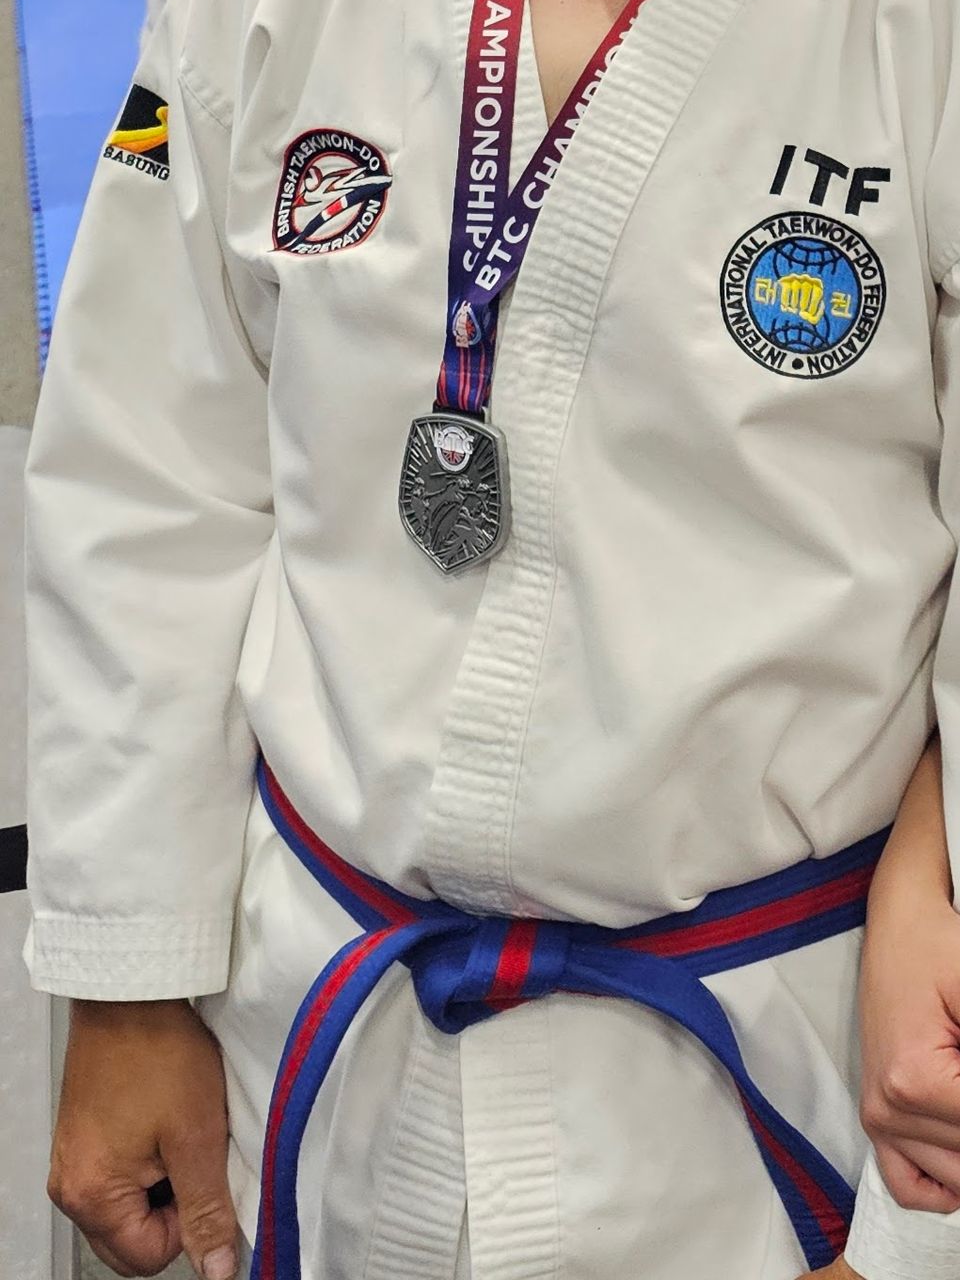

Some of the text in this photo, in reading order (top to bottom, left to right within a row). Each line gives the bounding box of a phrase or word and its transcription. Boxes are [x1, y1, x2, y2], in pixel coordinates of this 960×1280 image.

[277, 133, 381, 254] BRITISH TAEKWON-DO FEDERATION
[769, 144, 891, 216] ITF
[474, 215, 530, 291] BTC
[726, 215, 881, 375] INTERNATIONAL TAEKWON-DO FEDERATION
